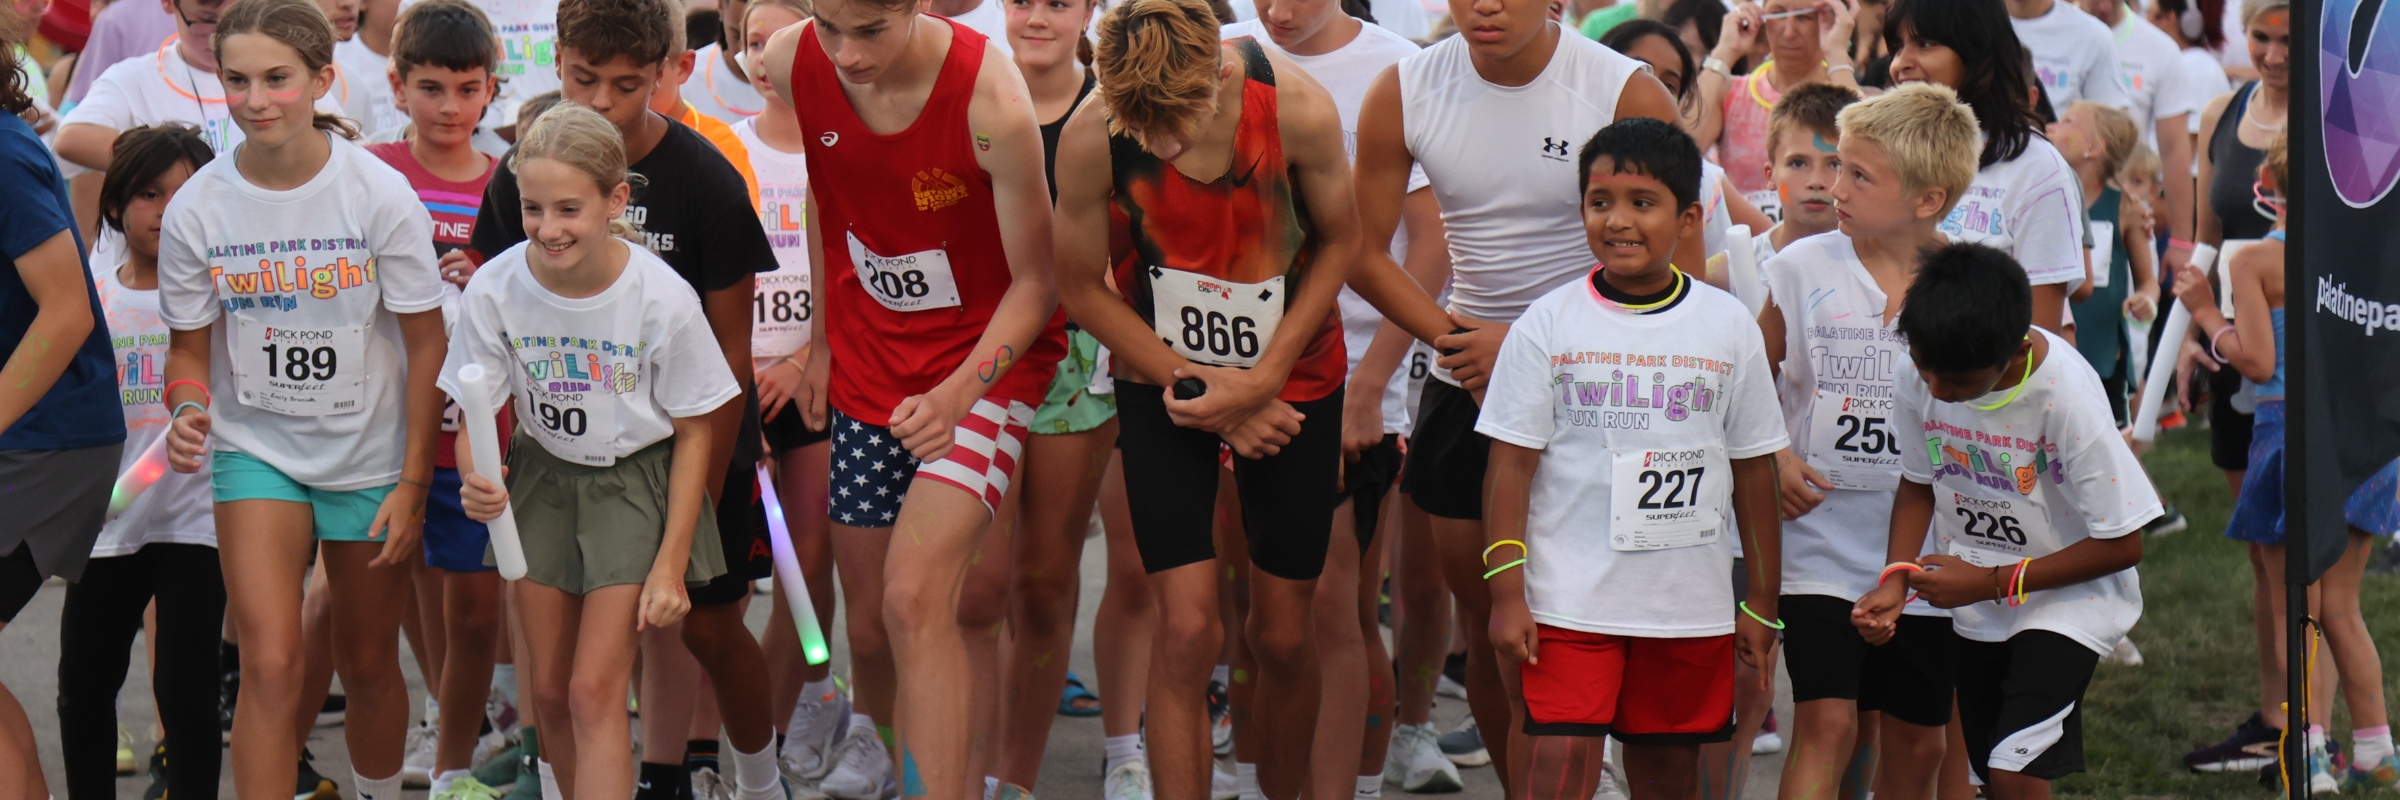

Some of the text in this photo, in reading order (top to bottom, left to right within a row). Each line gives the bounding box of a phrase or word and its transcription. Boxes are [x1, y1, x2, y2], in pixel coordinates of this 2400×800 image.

[621, 205, 648, 225] GO
[432, 220, 470, 238] TINE
[208, 238, 368, 258] ALATINE PARK DISTRIC
[885, 255, 916, 266] POND
[760, 274, 809, 285] DICK POND
[865, 260, 929, 299] 208
[223, 296, 255, 312] UN
[754, 290, 811, 323] 183
[139, 334, 170, 346] PAR
[273, 328, 333, 340] DICK POND
[1181, 305, 1259, 358] 866
[1808, 325, 1874, 340] PALATINE
[560, 336, 597, 350] PARK
[262, 343, 337, 381] 189
[1551, 352, 1734, 376] PALATINE PARK DISTRICT
[1811, 345, 1893, 381] TwiL
[123, 388, 164, 405] RUN
[551, 393, 583, 402] POND
[1852, 398, 1876, 409] DICK
[526, 388, 587, 436] 190
[1604, 411, 1649, 429] RUN
[1924, 420, 1972, 440] ALATINE
[1976, 431, 2011, 448] PARK
[1653, 449, 1705, 462] DICK POND
[1637, 466, 1705, 510] 227
[1960, 495, 1980, 506] DICK
[1980, 499, 2012, 510] POND
[1956, 507, 2028, 546] 226
